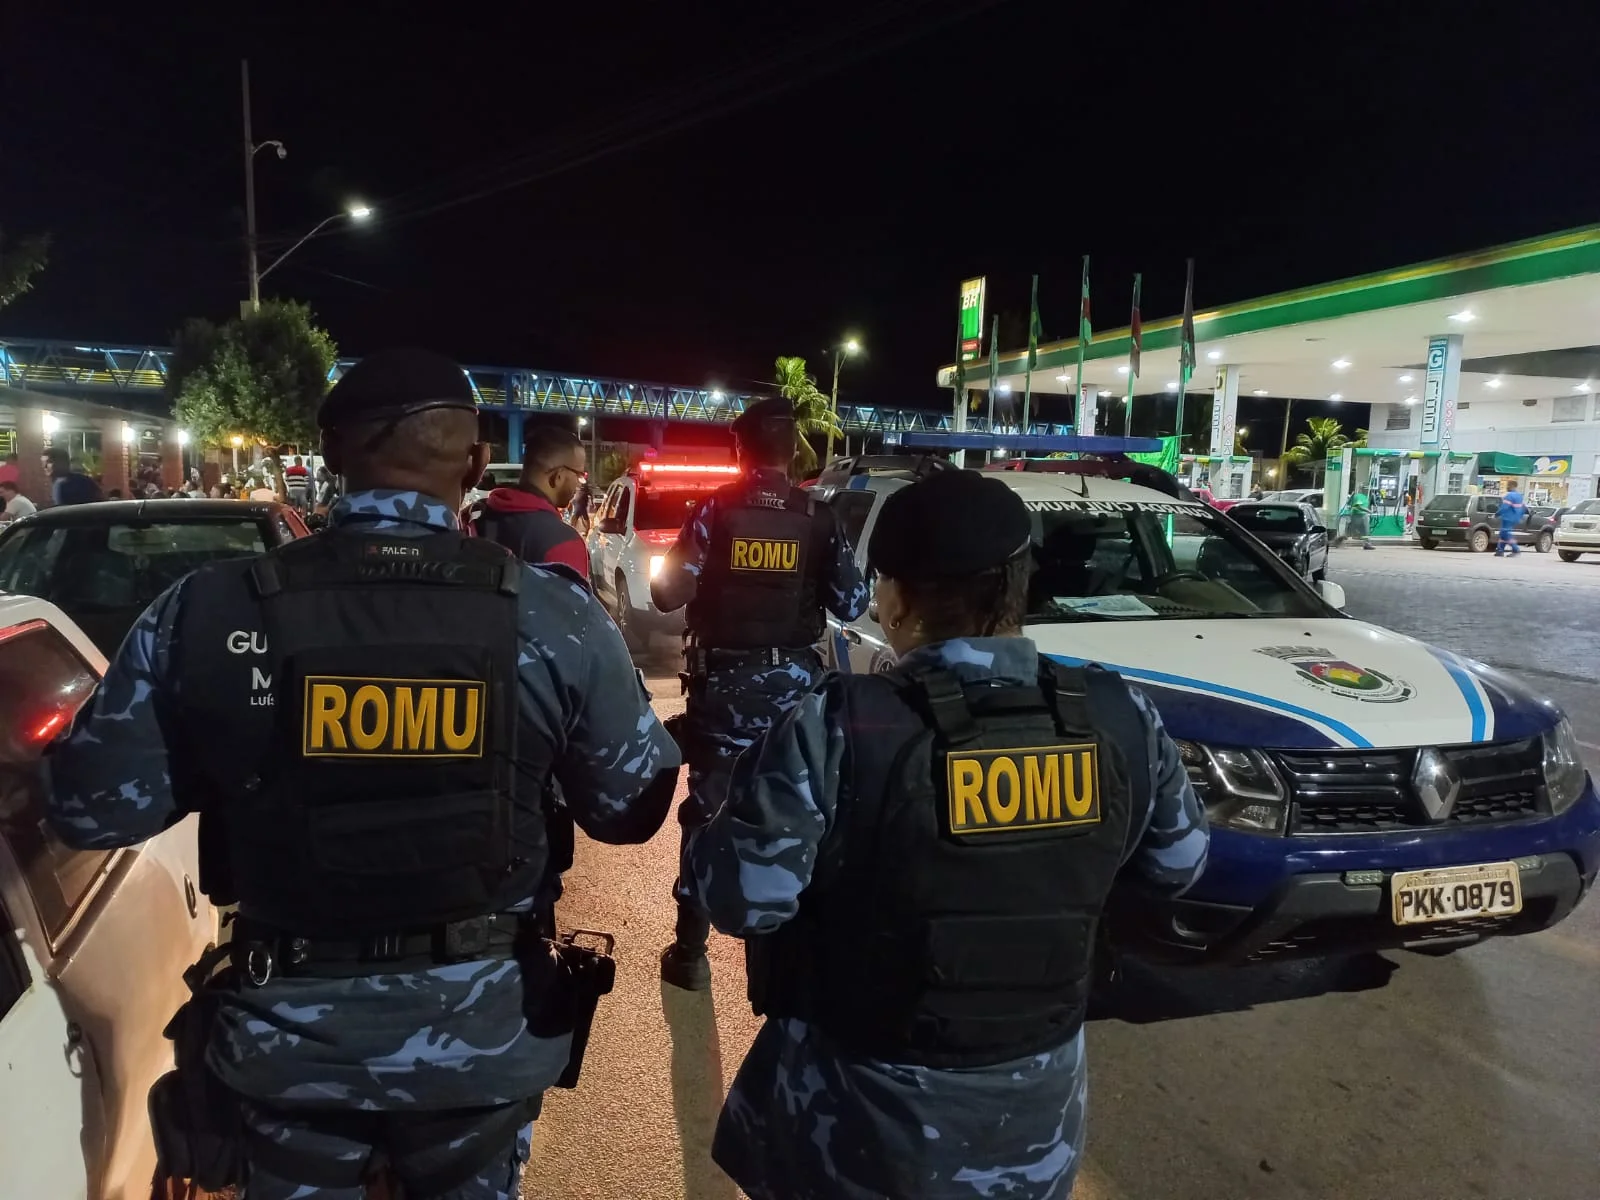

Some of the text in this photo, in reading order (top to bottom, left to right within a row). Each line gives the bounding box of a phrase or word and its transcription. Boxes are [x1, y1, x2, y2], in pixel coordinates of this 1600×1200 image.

[733, 540, 797, 570] ROMU
[226, 630, 268, 654] GU
[310, 684, 479, 750] ROMU
[953, 751, 1093, 825] ROMU
